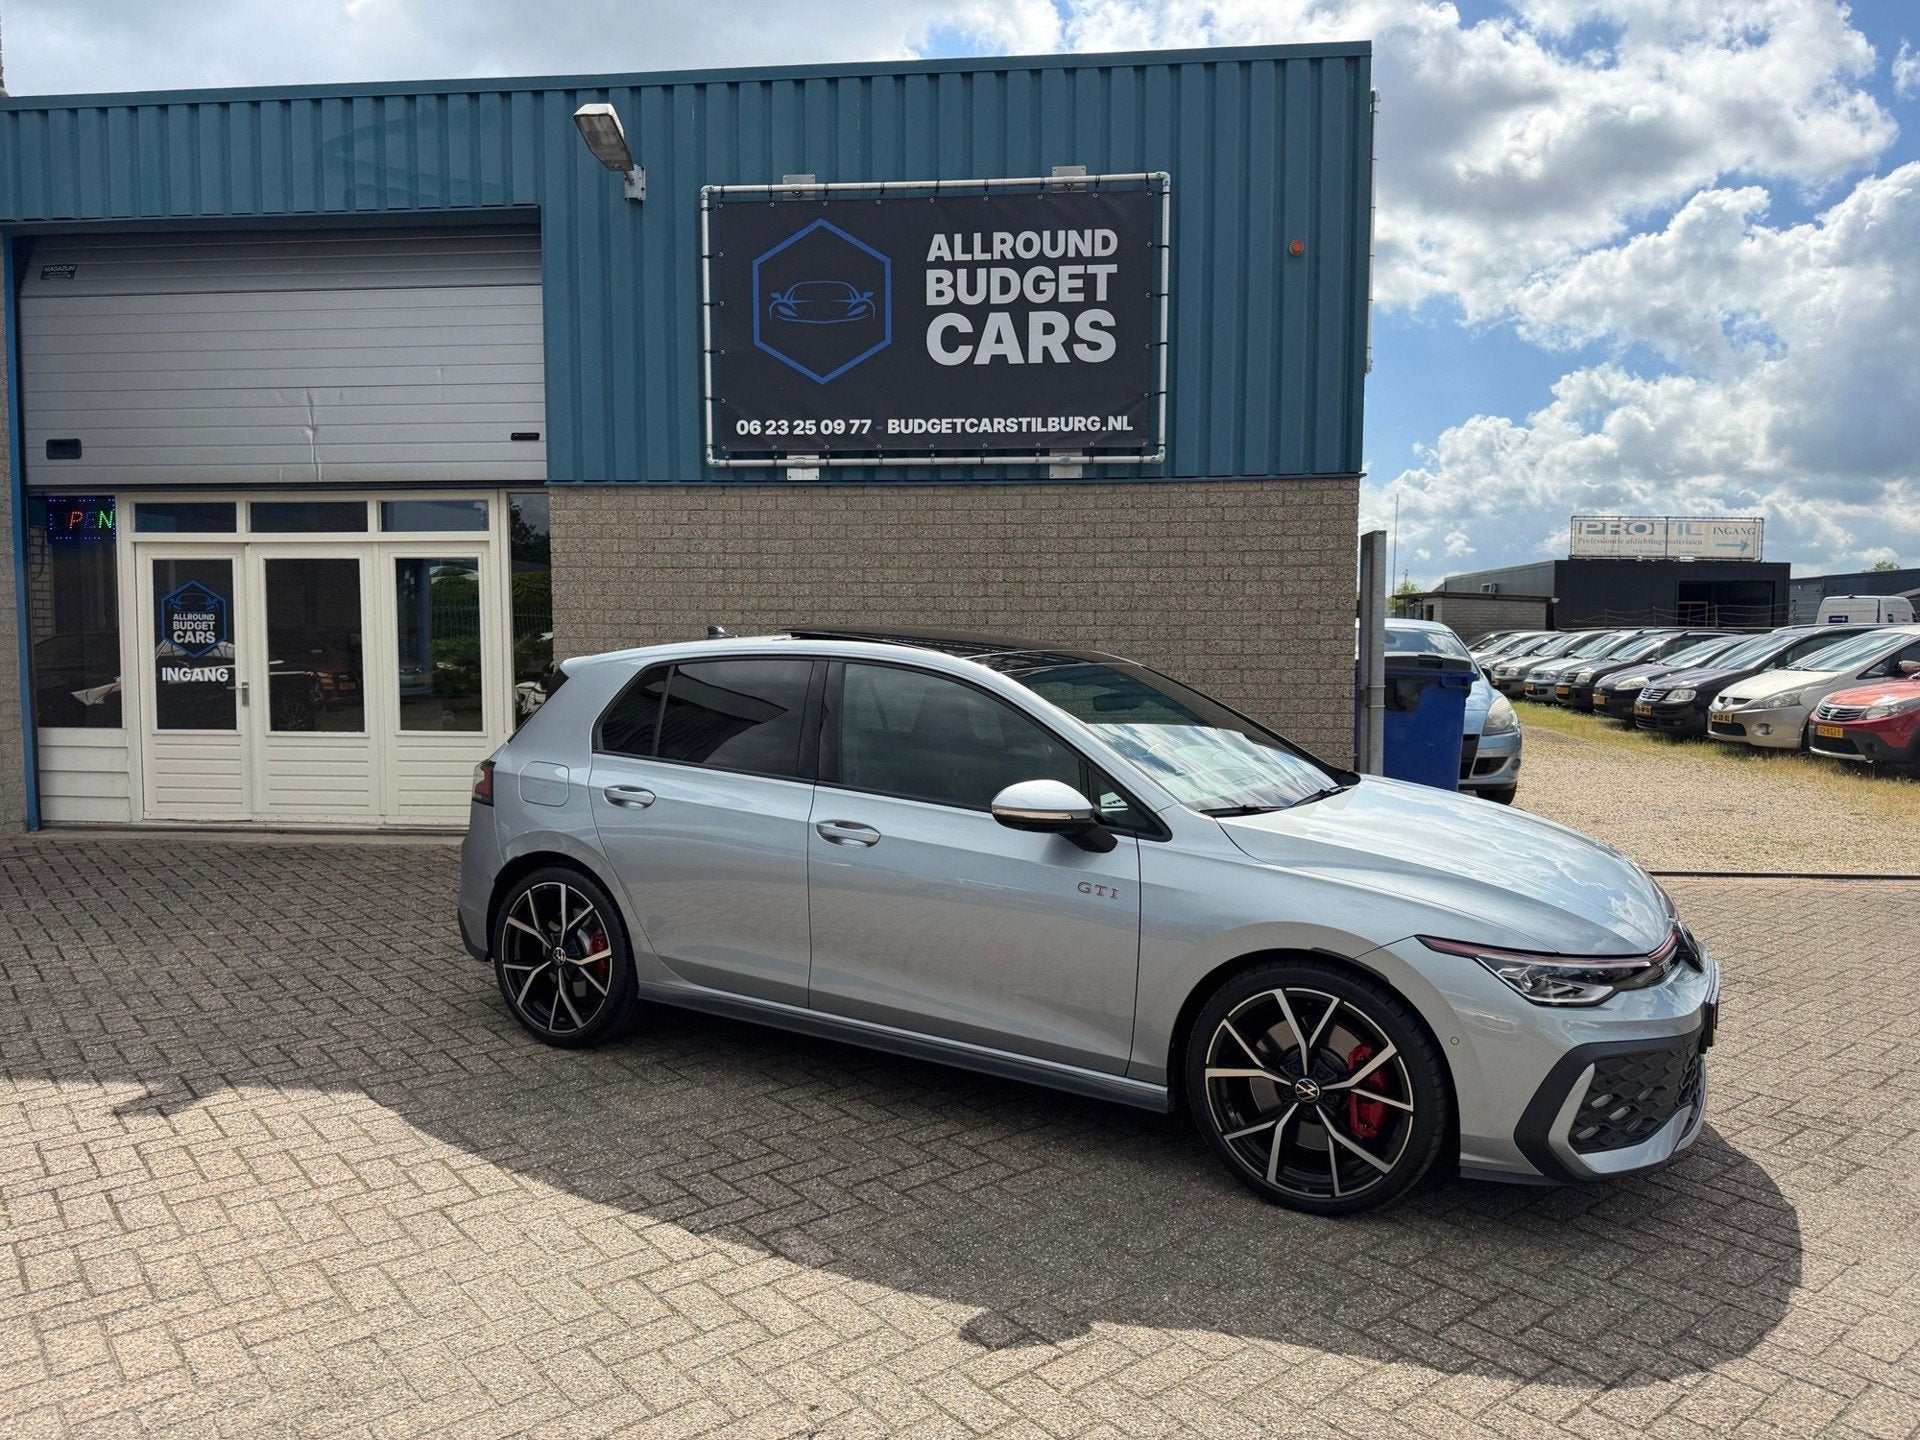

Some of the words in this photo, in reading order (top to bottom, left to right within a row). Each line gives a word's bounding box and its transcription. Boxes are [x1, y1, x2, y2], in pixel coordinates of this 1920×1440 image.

[926, 228, 1118, 262] ALLROUND
[926, 264, 1118, 306] BUDGET
[926, 308, 1117, 366] CARS
[736, 419, 762, 435] 06
[765, 419, 790, 435] 23
[792, 419, 817, 435] 25
[820, 419, 846, 435] 09
[849, 419, 872, 435] 77
[887, 415, 1134, 435] BUDGETCARSTILBURG.NL
[1578, 521, 1703, 536] PROTIL
[1713, 526, 1756, 536] INGANG
[173, 613, 216, 621] ALLROUND
[173, 621, 216, 630] BUDGET
[173, 630, 216, 644] CARS
[161, 667, 230, 682] INGANG
[1077, 881, 1119, 899] GTI
